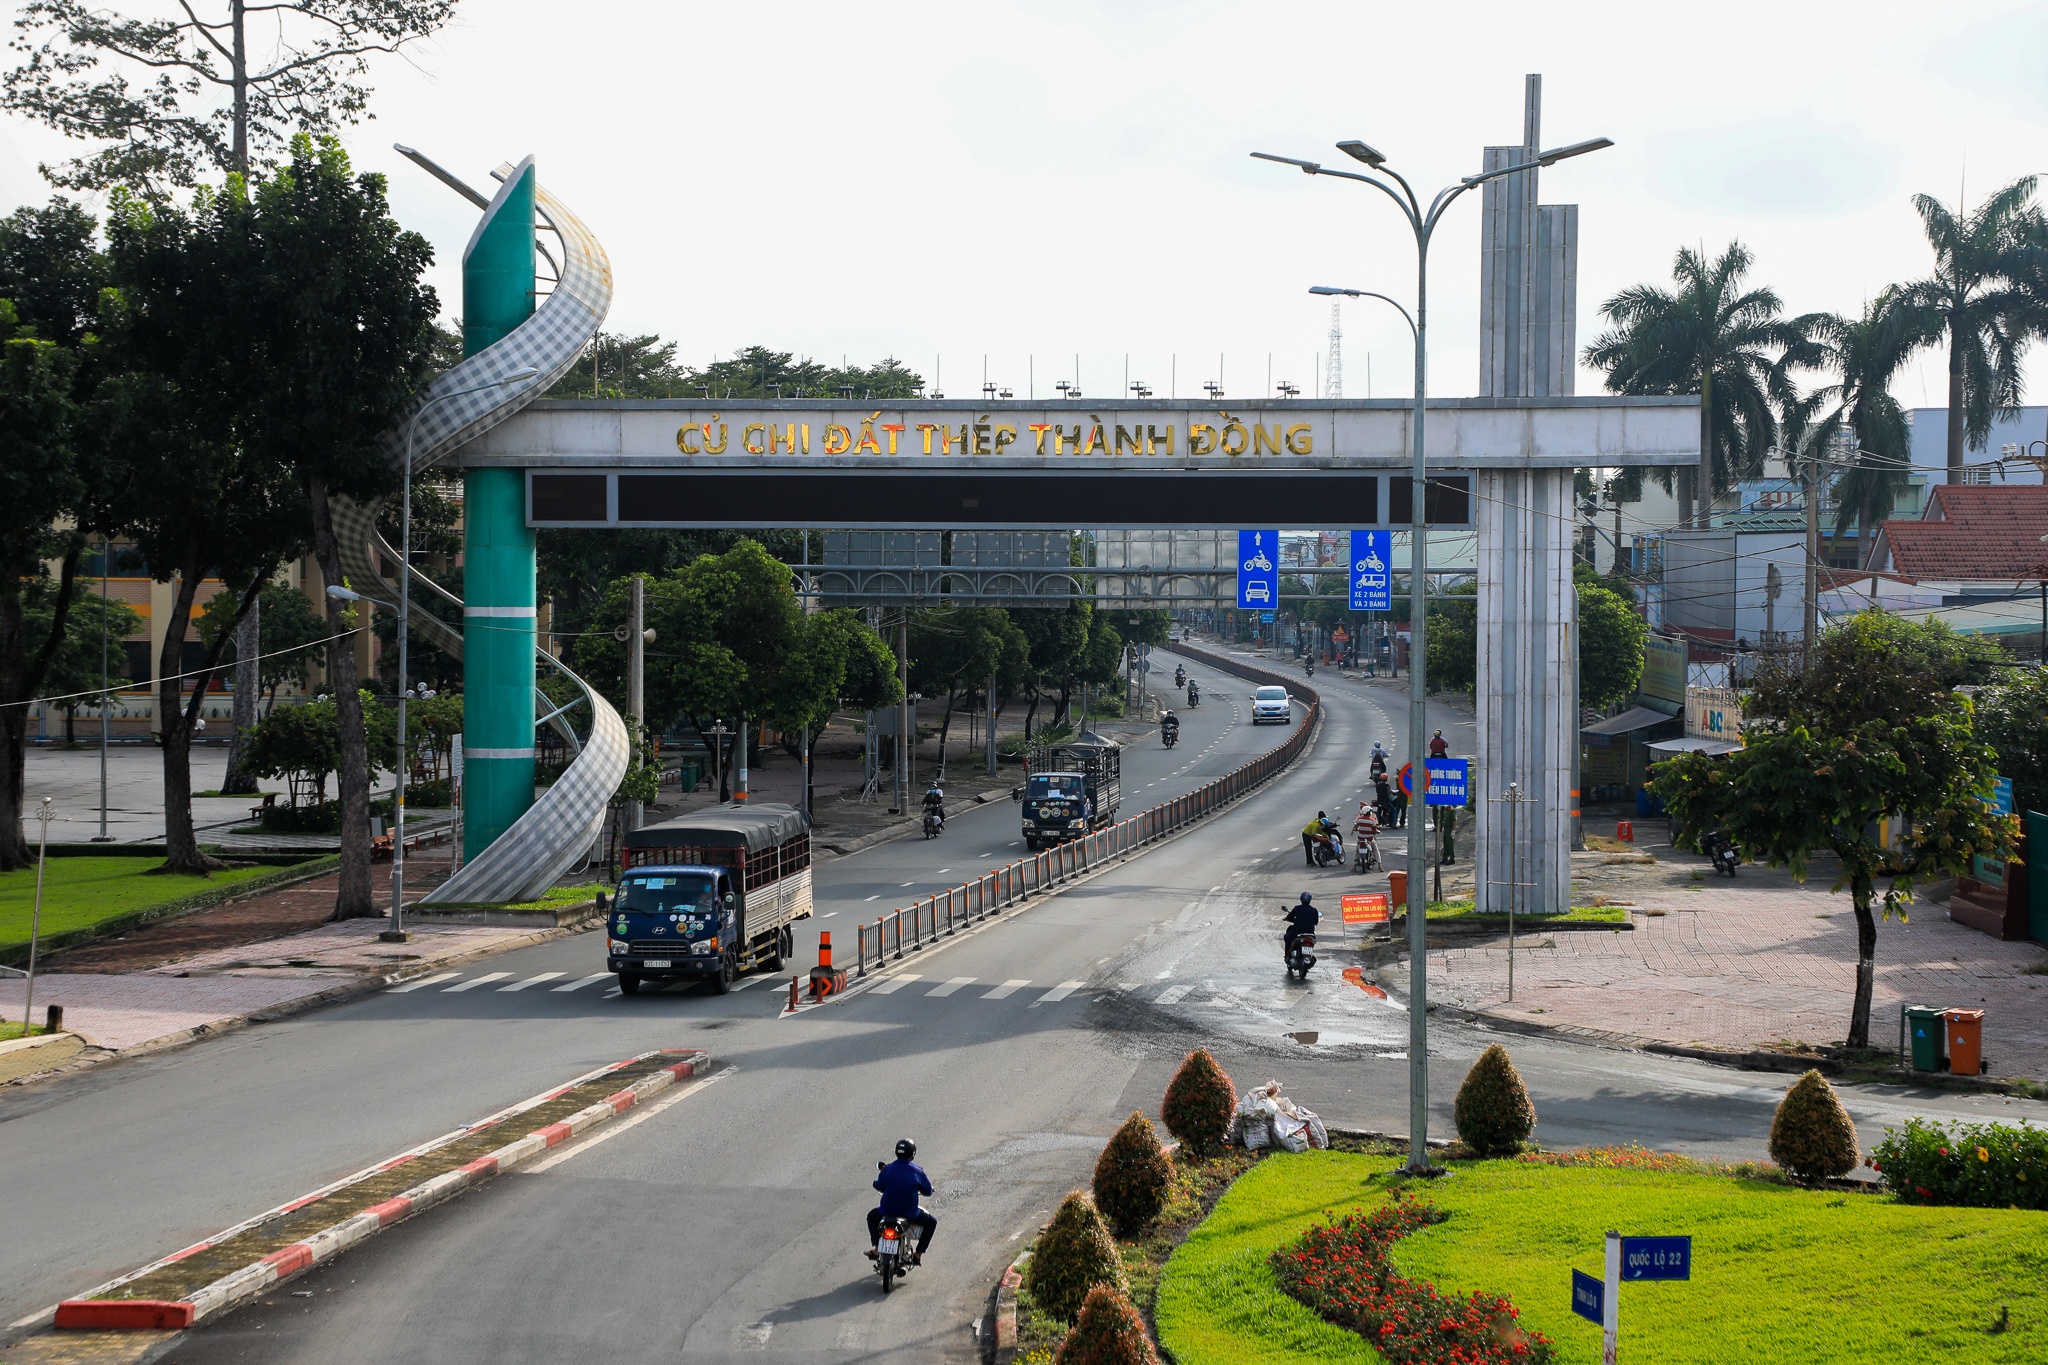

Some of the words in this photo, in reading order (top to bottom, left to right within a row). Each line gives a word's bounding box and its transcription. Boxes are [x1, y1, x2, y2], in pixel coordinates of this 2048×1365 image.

[676, 413, 728, 455] CỦ
[742, 424, 809, 455] CHI
[822, 410, 905, 455] ĐẤT
[916, 412, 1017, 455] THÉP
[1028, 414, 1174, 456] THÀNH
[1188, 410, 1313, 456] ĐỒNG
[1370, 590, 1386, 598] BÁNH
[1370, 600, 1386, 608] BÁNH
[1702, 708, 1723, 732] ABC
[1629, 1248, 1650, 1268] QUỐC
[1654, 1250, 1666, 1270] LỘ
[1669, 1252, 1681, 1266] 22
